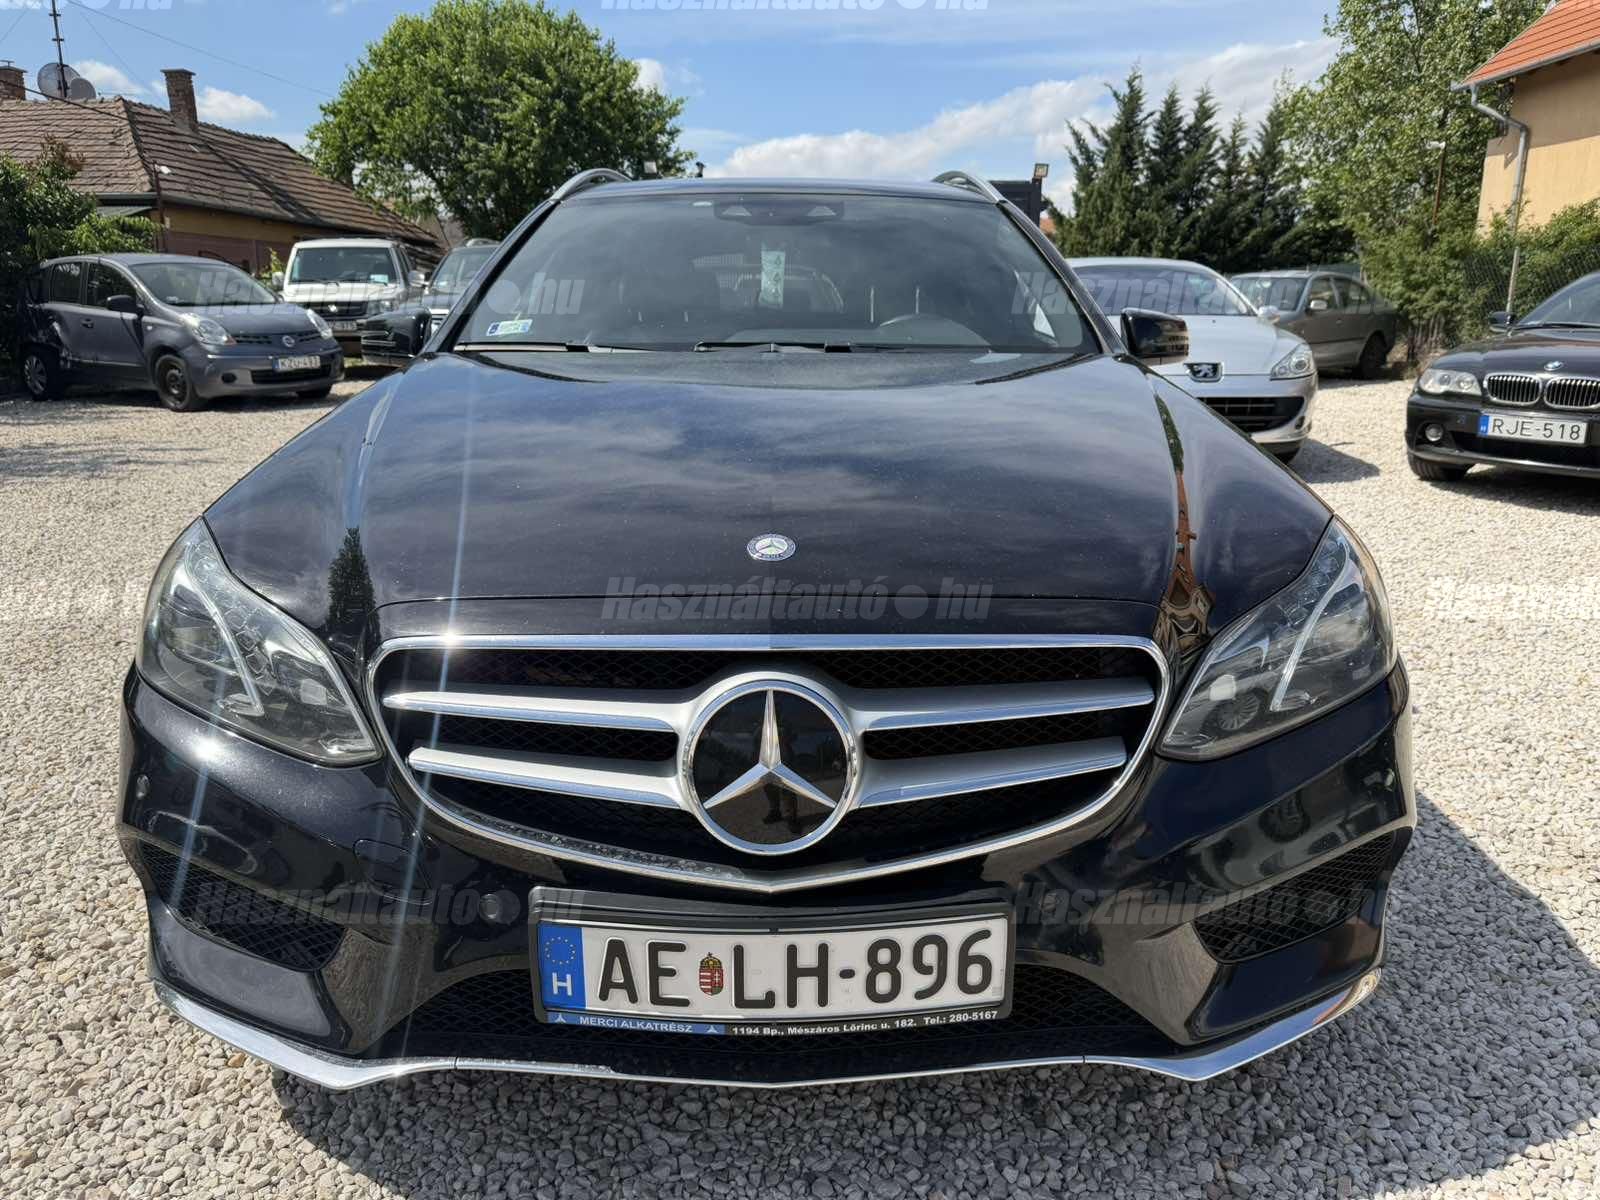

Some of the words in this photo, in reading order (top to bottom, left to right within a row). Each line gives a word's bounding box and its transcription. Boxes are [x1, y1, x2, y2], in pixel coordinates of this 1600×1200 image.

[1492, 418, 1581, 440] RJE-518
[552, 972, 572, 997] H
[597, 937, 691, 1007] AE
[732, 929, 993, 1009] LH-896
[579, 1015, 618, 1027] MERCI
[620, 1018, 693, 1034] ALKATRÉSZ
[732, 1026, 760, 1035] 1194
[788, 1024, 840, 1035] Mészáros
[881, 1021, 890, 1030] u.
[894, 1018, 917, 1029] 182.
[923, 1015, 946, 1026] Tel.:
[949, 1010, 998, 1023] 280-5167
